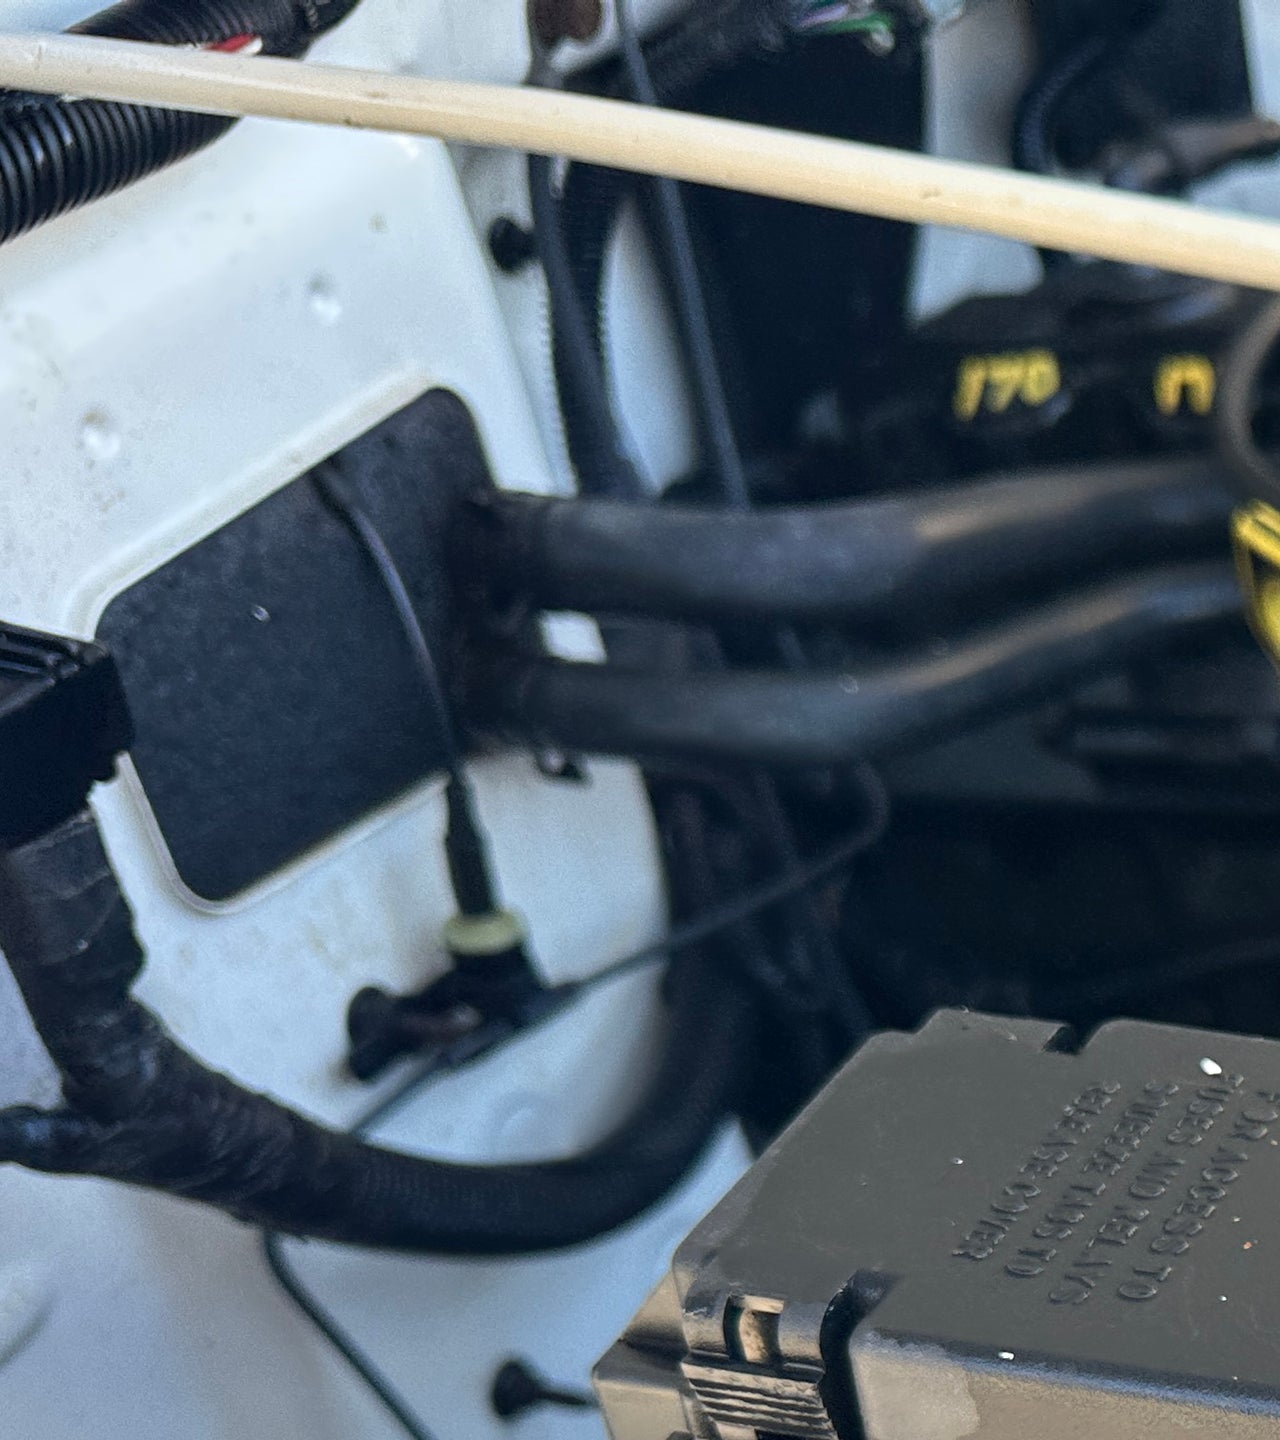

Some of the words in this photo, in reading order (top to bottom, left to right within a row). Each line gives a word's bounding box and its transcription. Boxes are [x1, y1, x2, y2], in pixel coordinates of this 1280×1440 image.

[1019, 1080, 1121, 1179] RELEASE
[1083, 1080, 1180, 1177] SQUEEZE
[1166, 1073, 1244, 1146] FUSES
[1033, 1182, 1107, 1240] TABS
[1128, 1151, 1187, 1200] AND
[1150, 1145, 1248, 1257] ACCESS
[951, 1182, 1042, 1260] COVER
[1048, 1205, 1149, 1304] RELAYS
[1004, 1246, 1057, 1277] TO
[1118, 1264, 1172, 1301] TO
